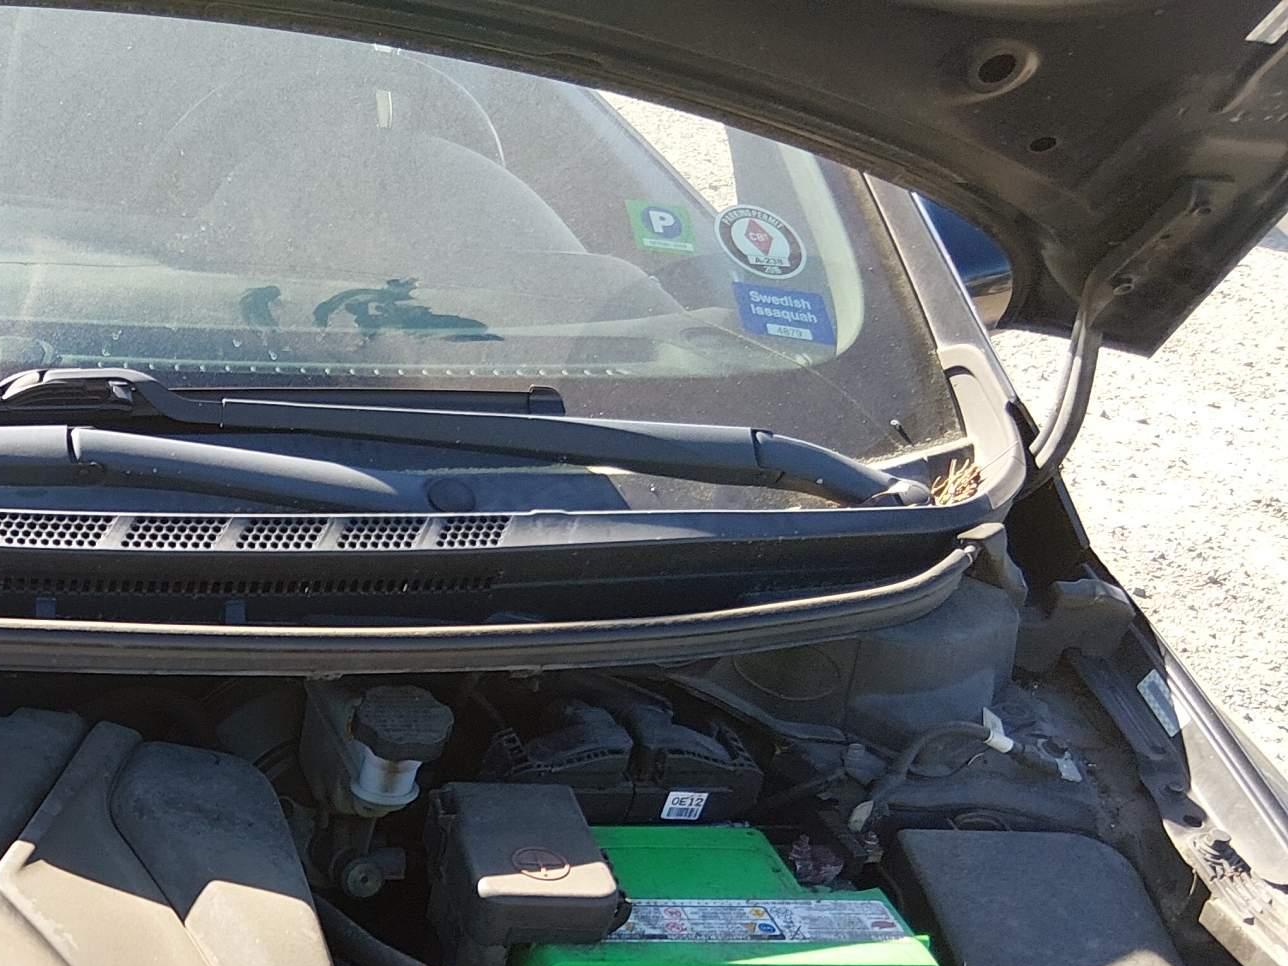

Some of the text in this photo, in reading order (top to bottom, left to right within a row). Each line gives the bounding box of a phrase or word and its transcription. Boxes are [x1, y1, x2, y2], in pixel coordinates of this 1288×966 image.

[648, 210, 675, 232] P
[751, 210, 783, 229] PERMIT
[749, 290, 812, 310] Swedish
[750, 303, 818, 323] Issaquah
